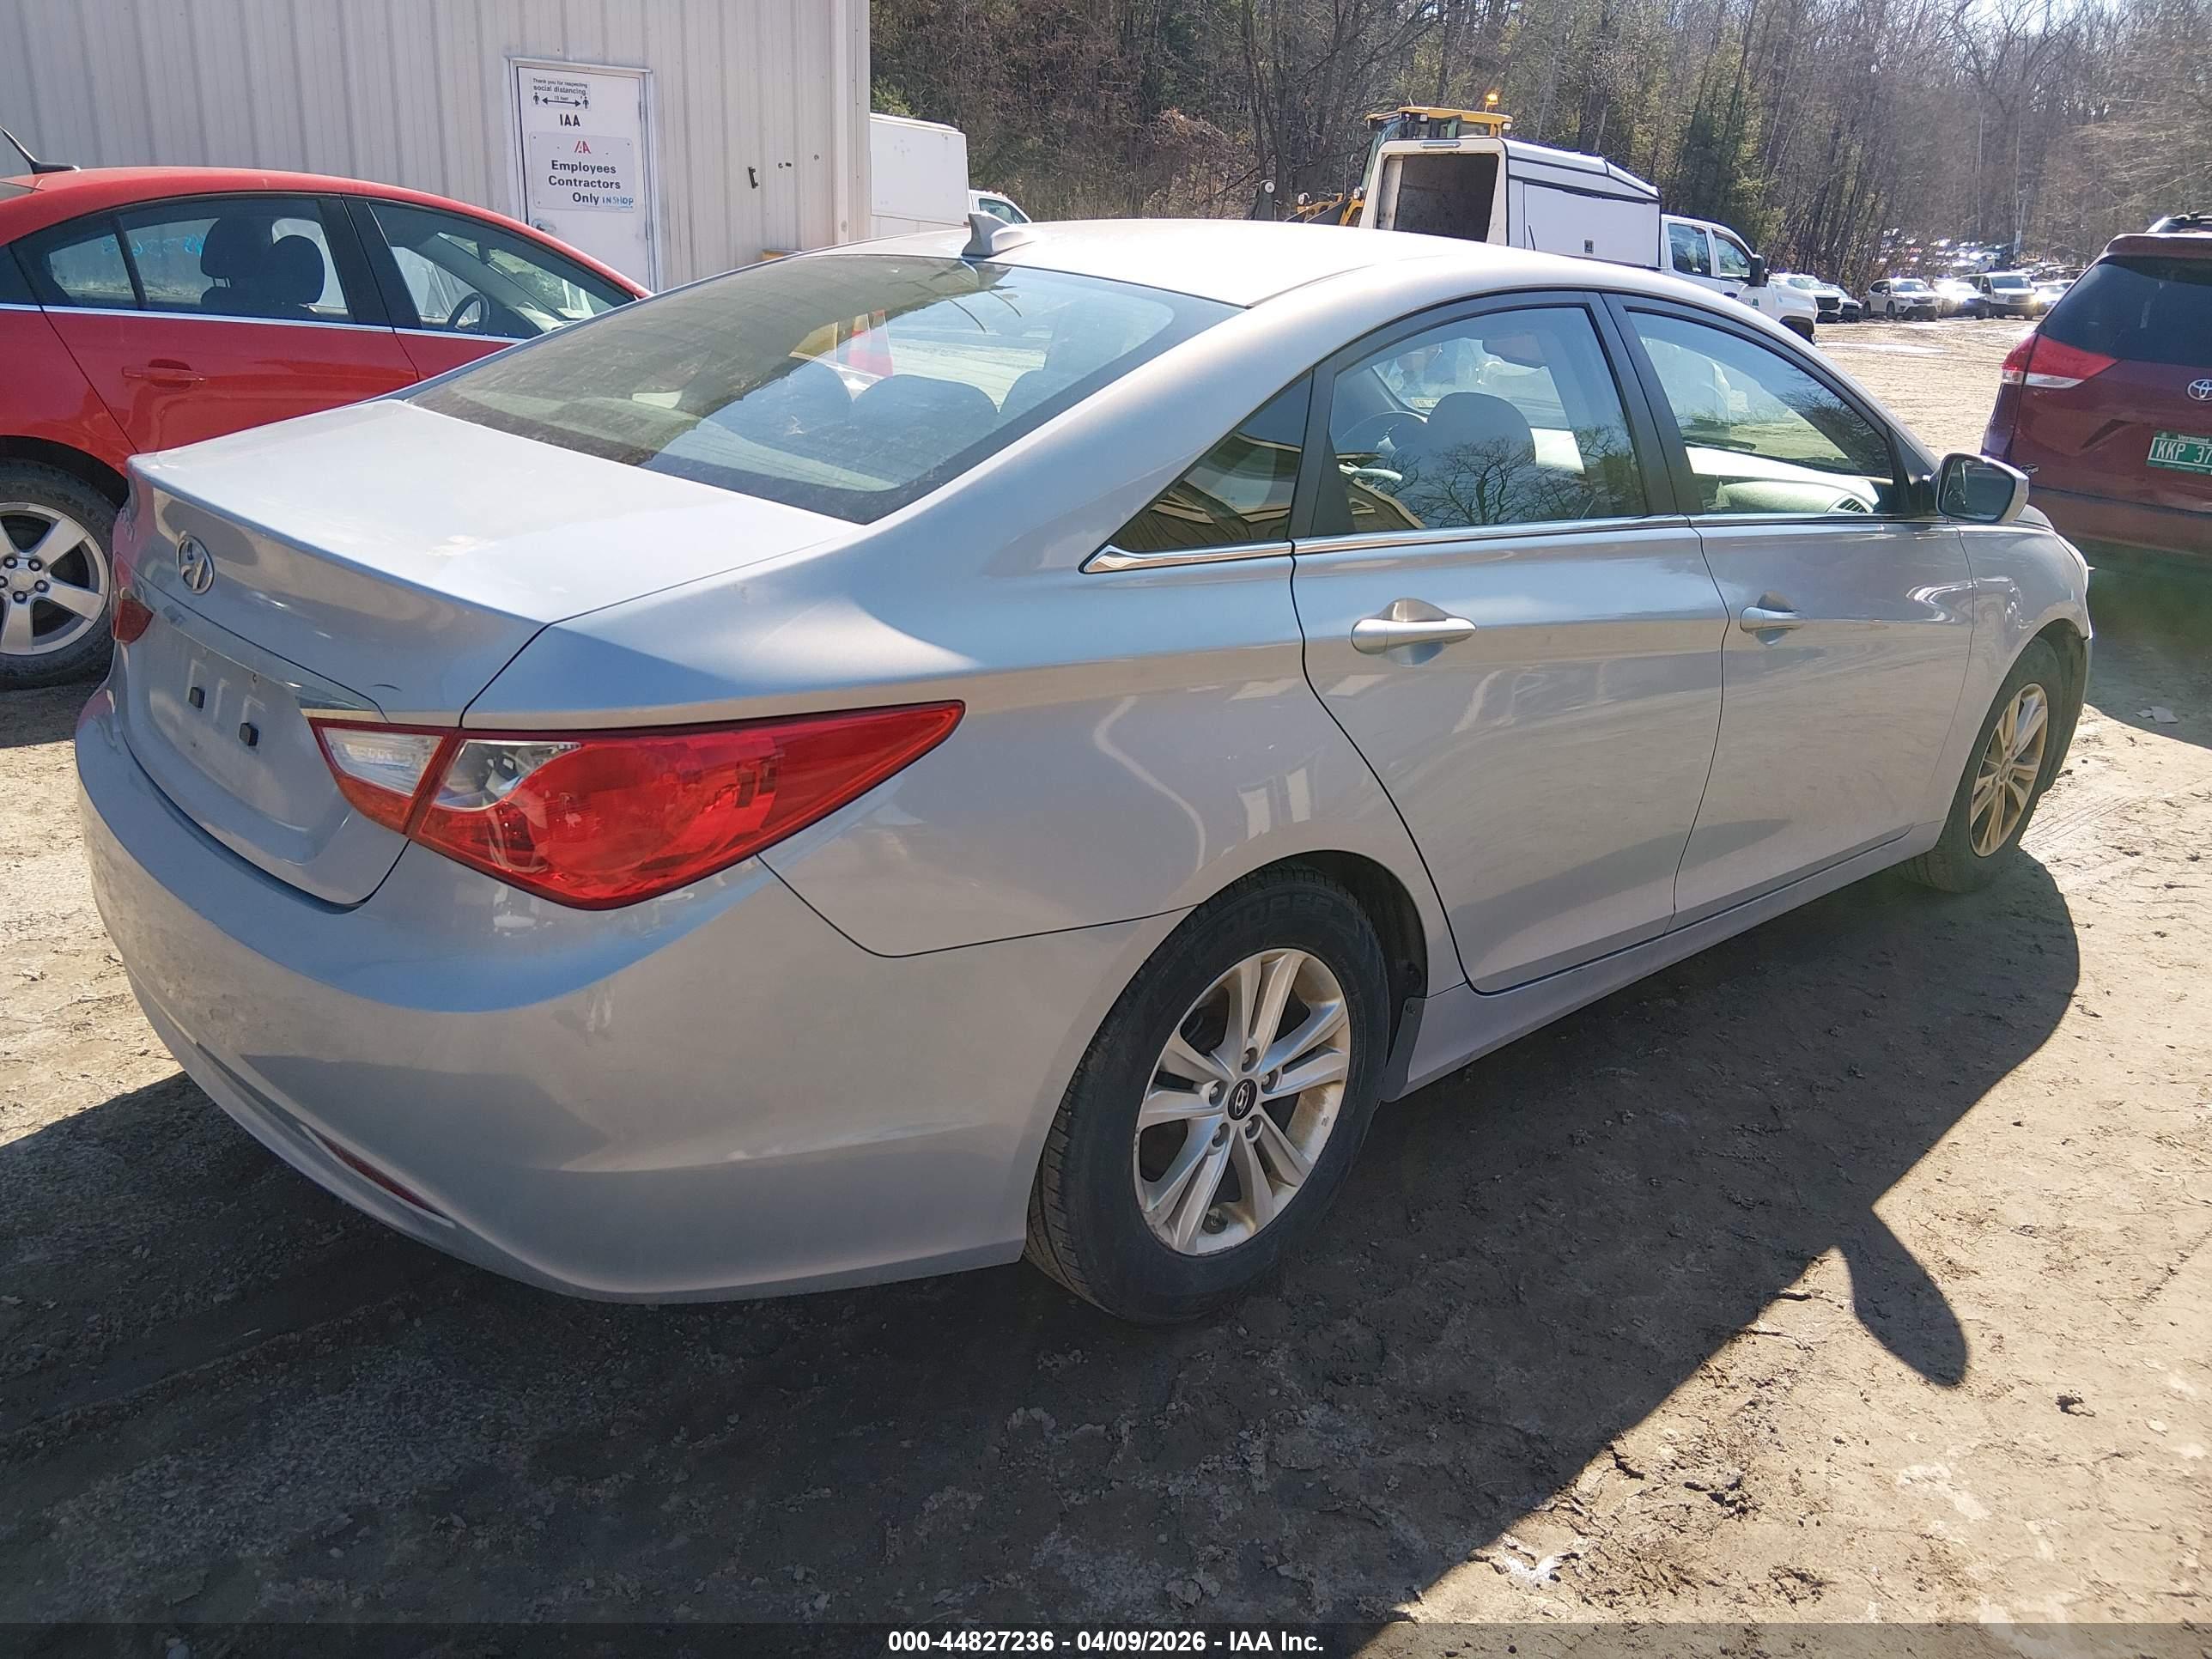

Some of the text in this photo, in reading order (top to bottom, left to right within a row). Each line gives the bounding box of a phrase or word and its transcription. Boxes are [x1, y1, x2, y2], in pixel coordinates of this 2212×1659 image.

[554, 86, 586, 96] distancing
[560, 113, 580, 127] IAA
[550, 160, 617, 175] Employees
[548, 175, 621, 190] Contractors
[572, 191, 599, 205] Only
[2178, 434, 2210, 444] Vermont
[2156, 441, 2186, 461] KKP
